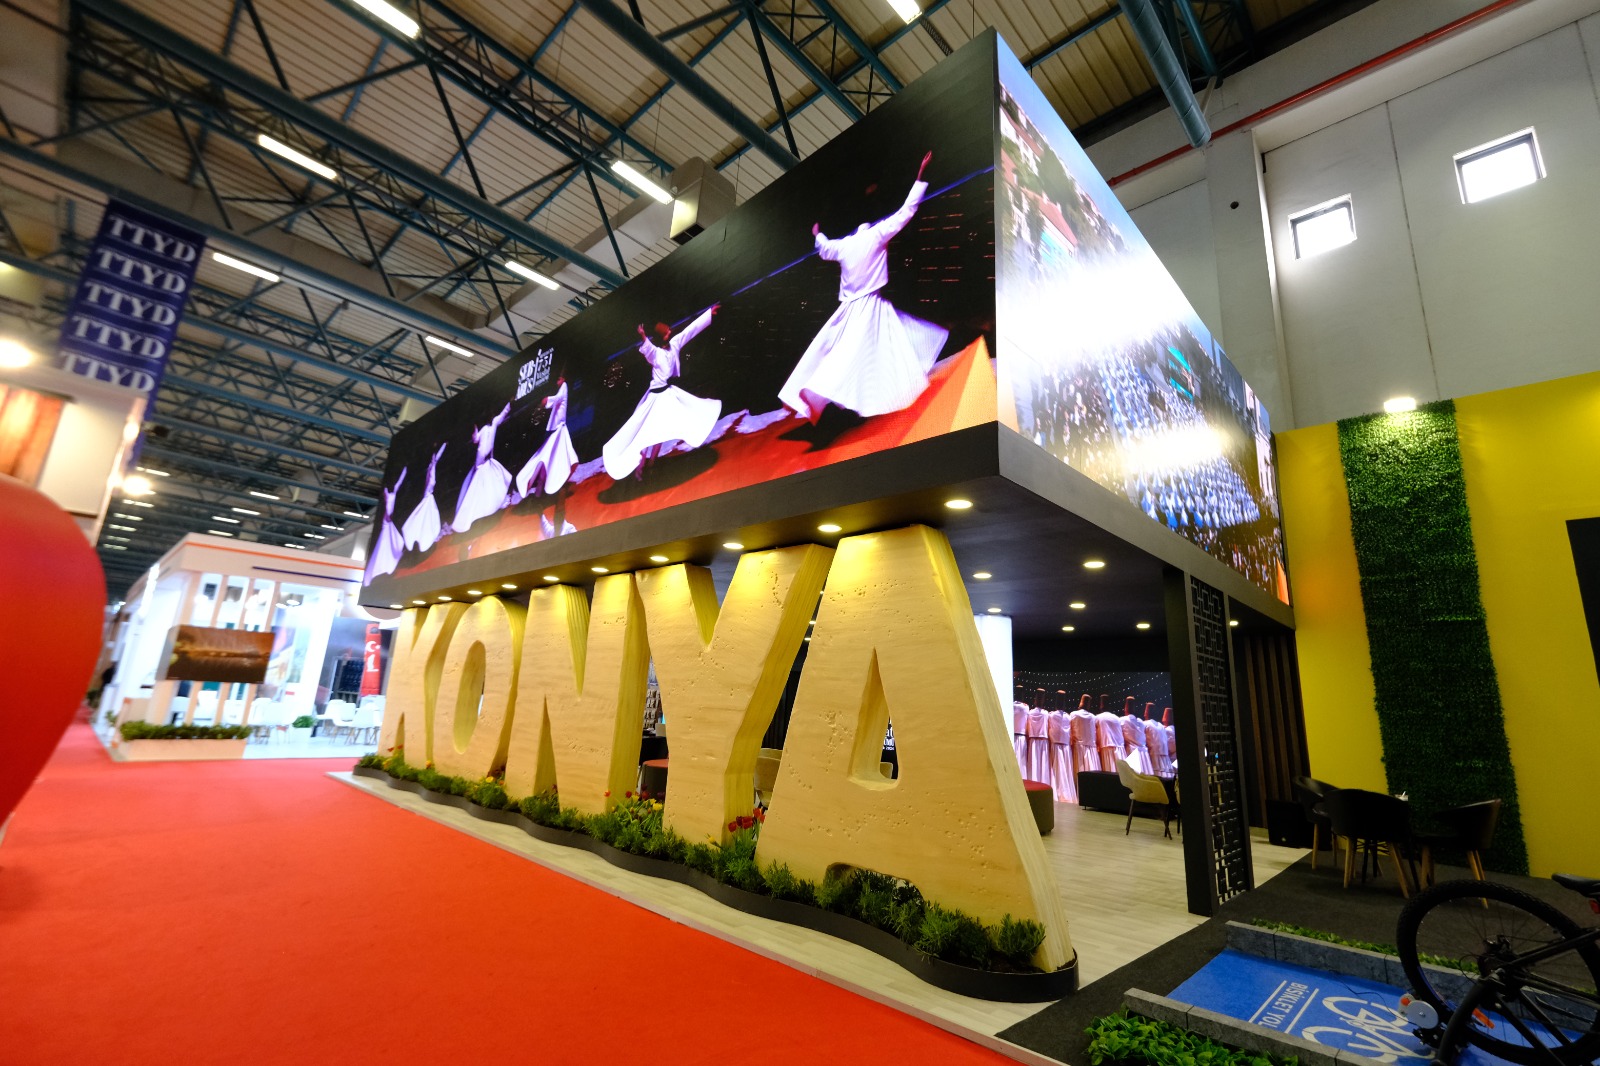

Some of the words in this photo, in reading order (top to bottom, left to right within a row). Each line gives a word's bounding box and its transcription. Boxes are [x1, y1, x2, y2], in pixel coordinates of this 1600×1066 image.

[109, 215, 196, 263] TTYD
[98, 250, 187, 294] TTYD
[85, 281, 176, 326] TTYD
[72, 315, 166, 359] TTYD
[59, 351, 155, 393] TTYD
[377, 522, 1074, 973] KONYA
[1272, 982, 1309, 1013] BİSİKLET
